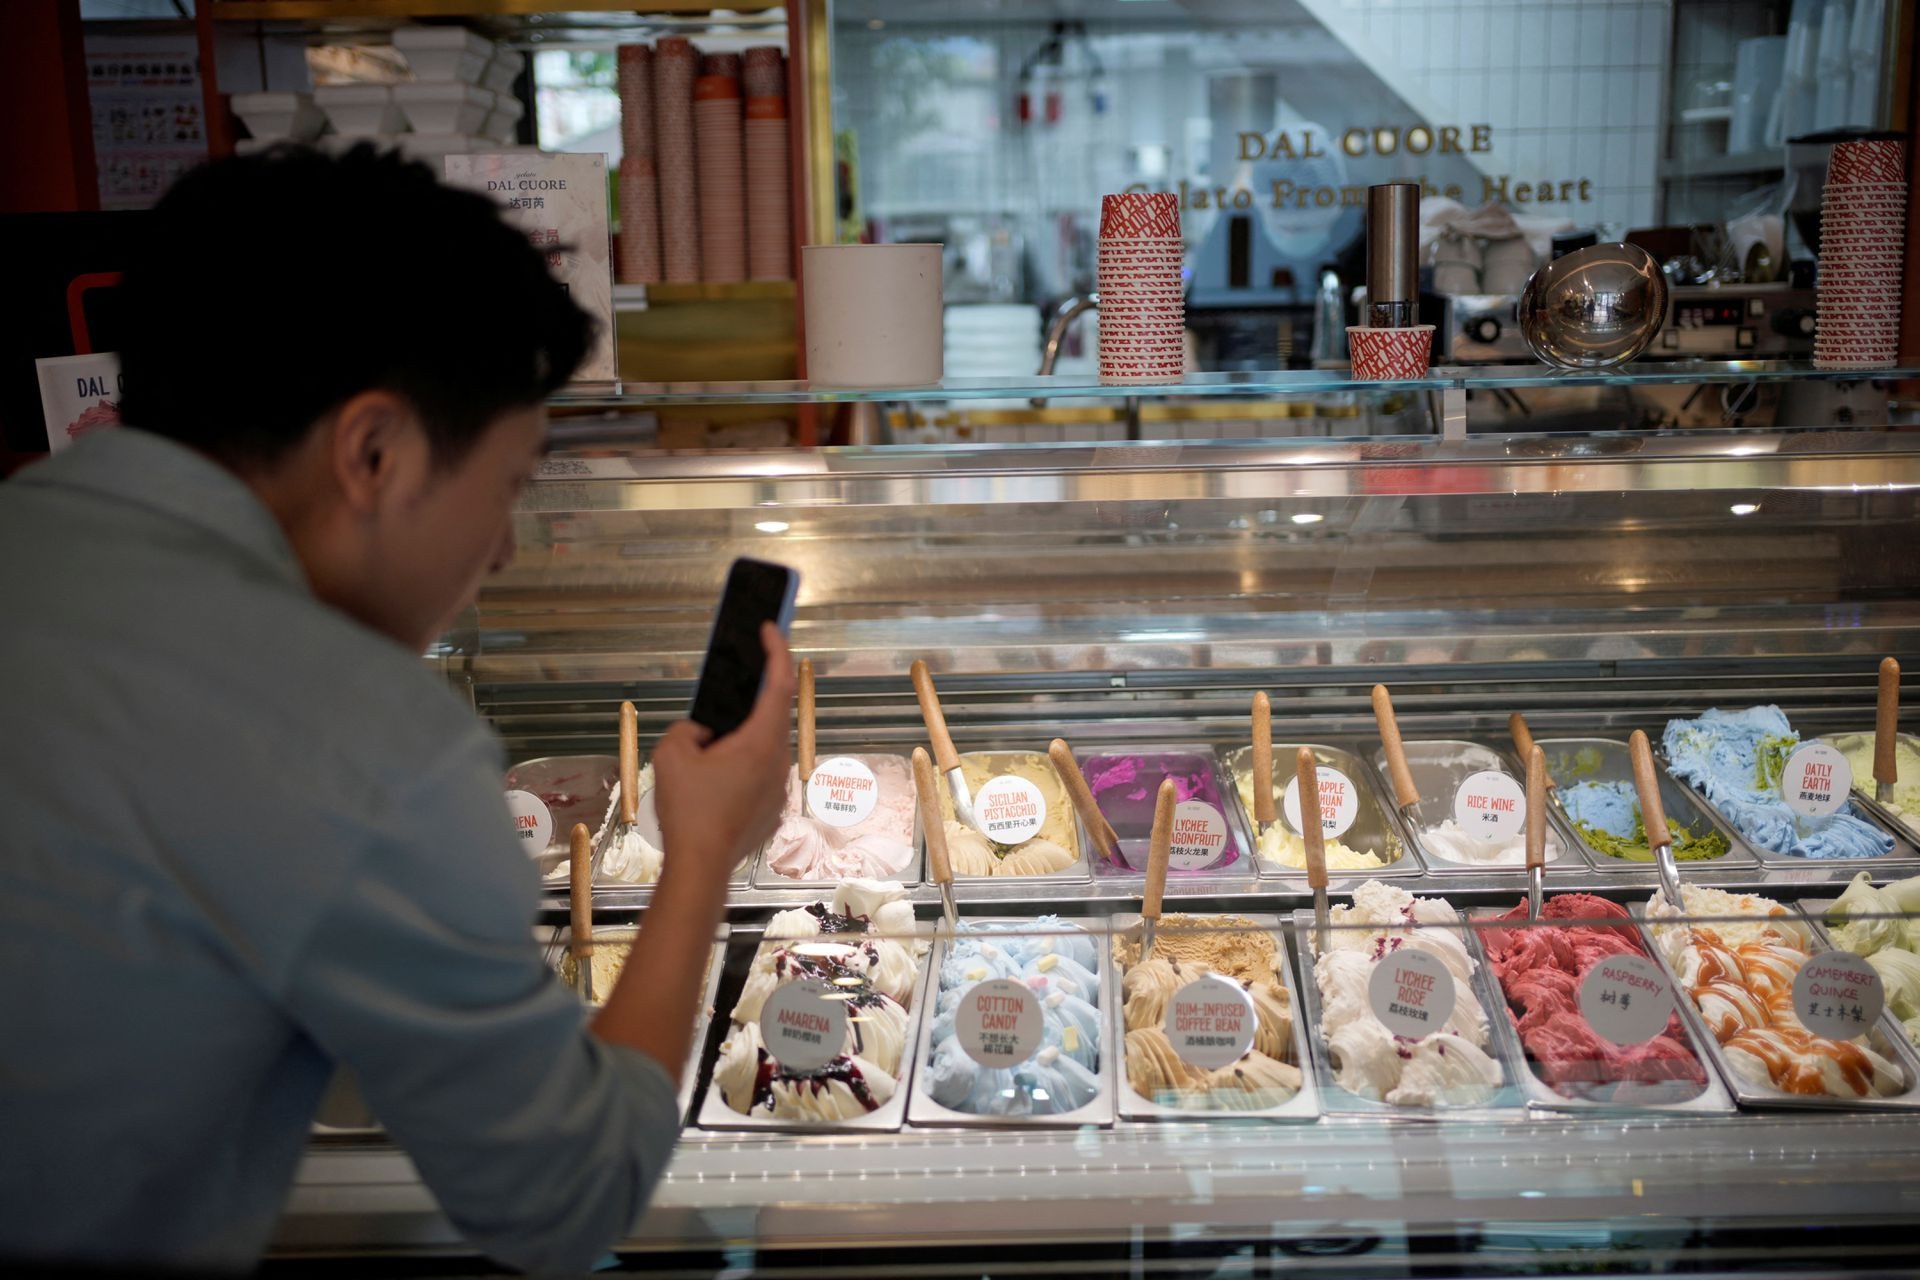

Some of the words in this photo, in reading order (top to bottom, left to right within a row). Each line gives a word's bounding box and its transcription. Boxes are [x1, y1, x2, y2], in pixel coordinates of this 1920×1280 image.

[1237, 131, 1324, 160] DAL
[1342, 124, 1493, 157] CUORE
[487, 180, 515, 191] DAL
[518, 179, 567, 191] CUORE
[1124, 179, 1253, 210] lato
[1271, 178, 1369, 209] From
[1480, 174, 1593, 204] Heart
[509, 197, 544, 209] 达可芮
[77, 376, 110, 398] DAL
[1805, 762, 1833, 777] OATLY
[814, 773, 874, 791] STRAWBERRY
[1802, 776, 1831, 791] EARTH
[829, 789, 855, 802] MILK
[988, 791, 1029, 807] SICILIAN
[1320, 794, 1343, 806] HUAN
[1467, 795, 1488, 809] RICE
[1491, 797, 1515, 812] WINE
[824, 801, 857, 814] 草莓鲜奶
[984, 803, 1037, 820] PISTACCHIO
[514, 815, 538, 829] RENA
[988, 818, 1037, 831] 西西里开心果
[1175, 818, 1209, 833] LYCHEE
[1482, 813, 1499, 823] 米酒
[1170, 832, 1223, 847] AGONFRUIT
[1394, 967, 1436, 992] LYCHEE
[1602, 967, 1664, 998] RASPBERRY
[1806, 966, 1875, 987] CAMEMBERT
[1397, 986, 1427, 1007] ROSE
[1809, 983, 1859, 1000] QUINCE
[976, 995, 1024, 1013] COTTON
[1175, 1001, 1246, 1017] RUM-INFUSED
[777, 1008, 831, 1033] AMARENA
[982, 1013, 1018, 1030] CANDY
[1175, 1017, 1212, 1032] COFFEE
[1215, 1018, 1241, 1033] BEAN
